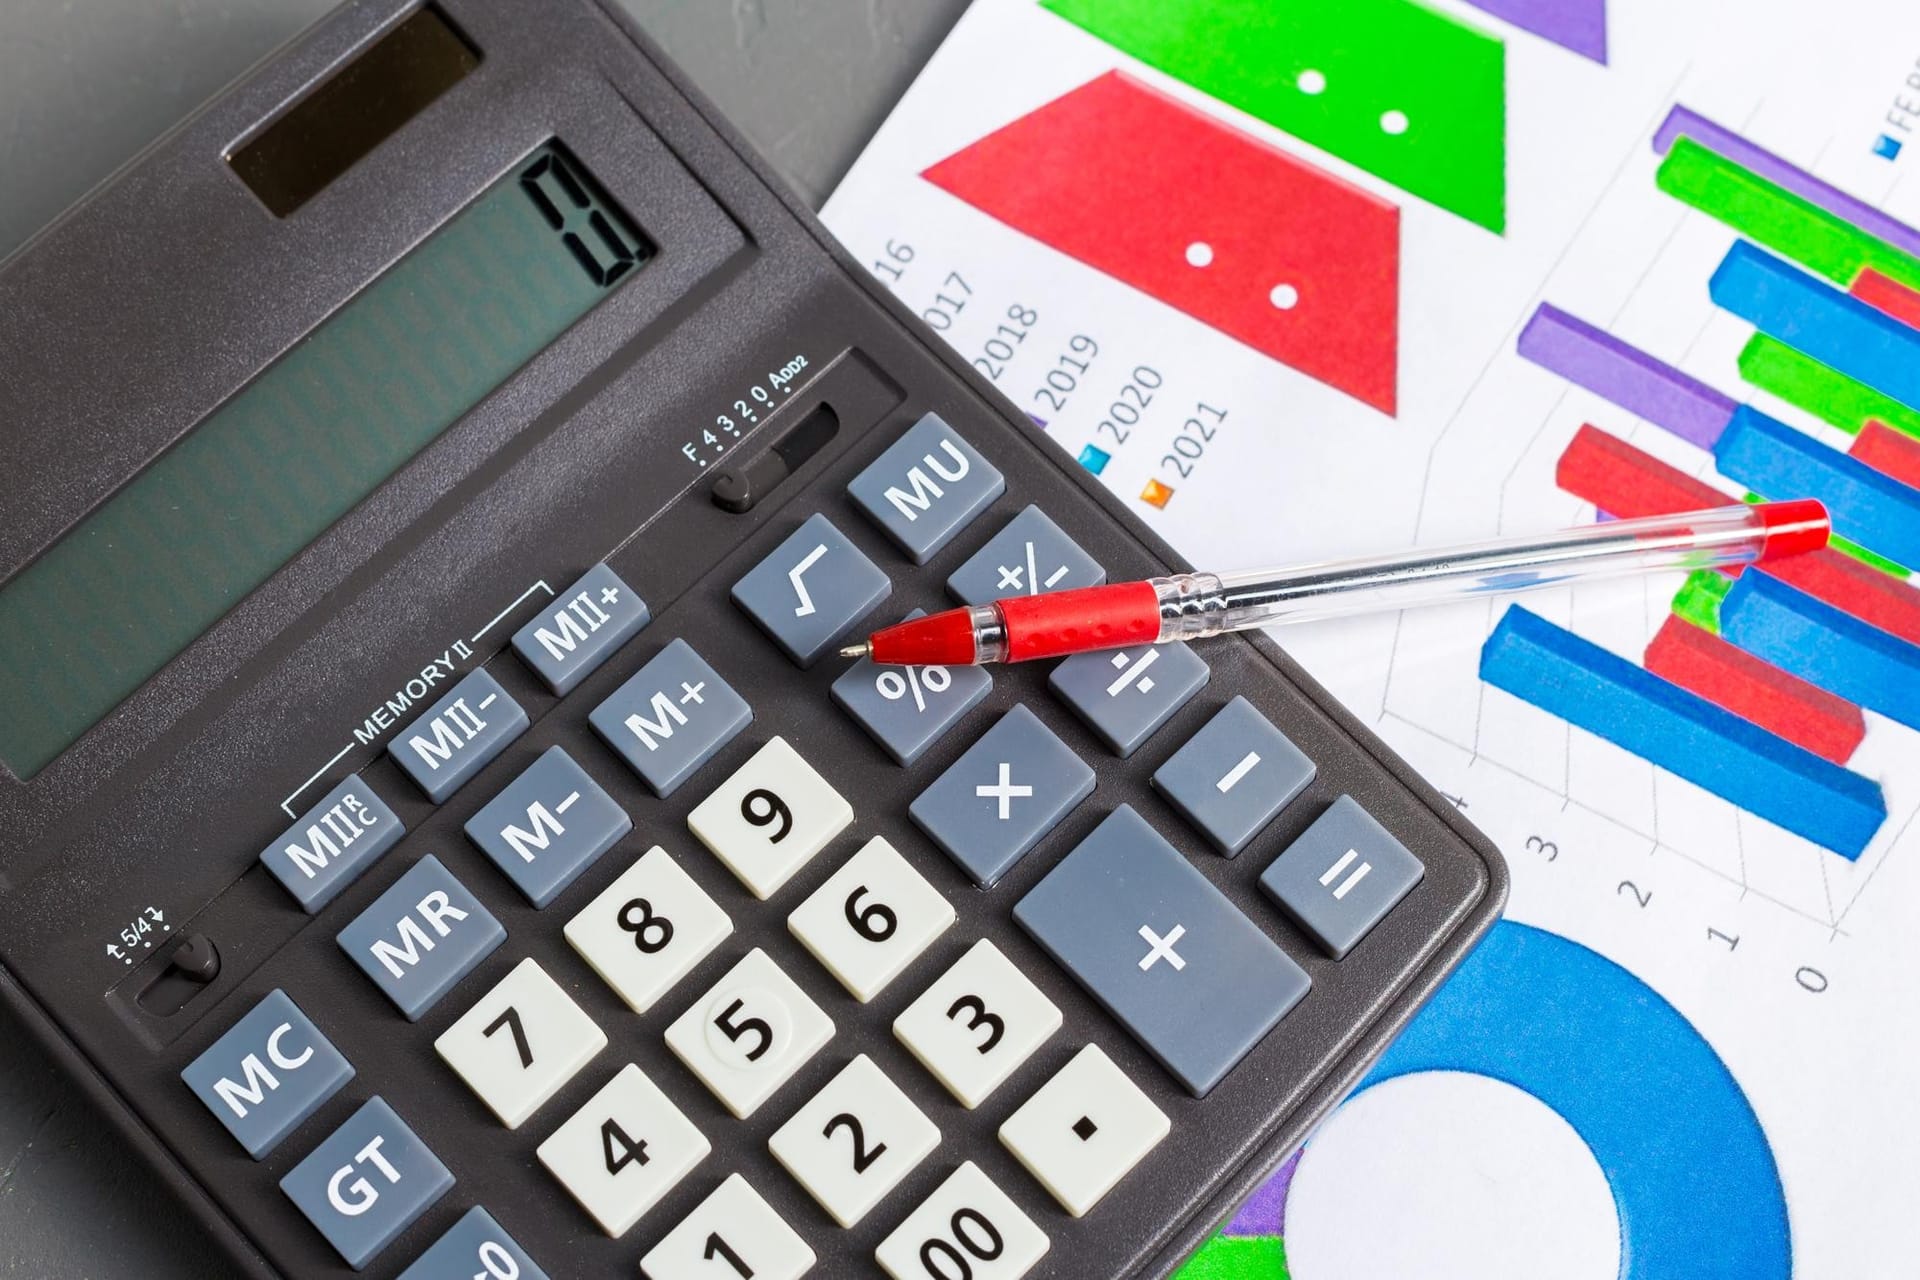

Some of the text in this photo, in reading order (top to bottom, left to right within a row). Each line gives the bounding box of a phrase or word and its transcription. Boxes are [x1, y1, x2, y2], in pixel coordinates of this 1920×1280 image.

[873, 239, 915, 282] 16
[922, 271, 972, 331] 017
[974, 304, 1038, 381] 2018
[1034, 334, 1098, 412] 2019
[682, 442, 697, 462] F
[703, 429, 718, 445] 4
[716, 415, 735, 432] 3
[733, 400, 753, 418] 2
[750, 385, 768, 402] 0
[1098, 366, 1162, 445] 2020
[1161, 402, 1228, 479] 2021
[883, 439, 971, 522] MU
[353, 654, 457, 746] MEMORY
[624, 681, 705, 752] M+
[740, 788, 793, 844] 9
[1526, 835, 1559, 862] 3
[844, 885, 898, 943] 6
[1617, 880, 1652, 908] 2
[120, 916, 152, 947] 5/4
[370, 890, 469, 979] MR
[617, 898, 674, 954] 8
[1707, 926, 1740, 952] 1
[1795, 966, 1829, 993] 0
[482, 1006, 534, 1069] 7
[713, 998, 773, 1062] 5
[946, 994, 1005, 1055] 3
[213, 1022, 314, 1118] MC
[601, 1118, 650, 1176] 4
[822, 1112, 887, 1175] 2
[327, 1135, 401, 1216] GT
[703, 1231, 755, 1280] 1
[919, 1207, 1004, 1280] 00
